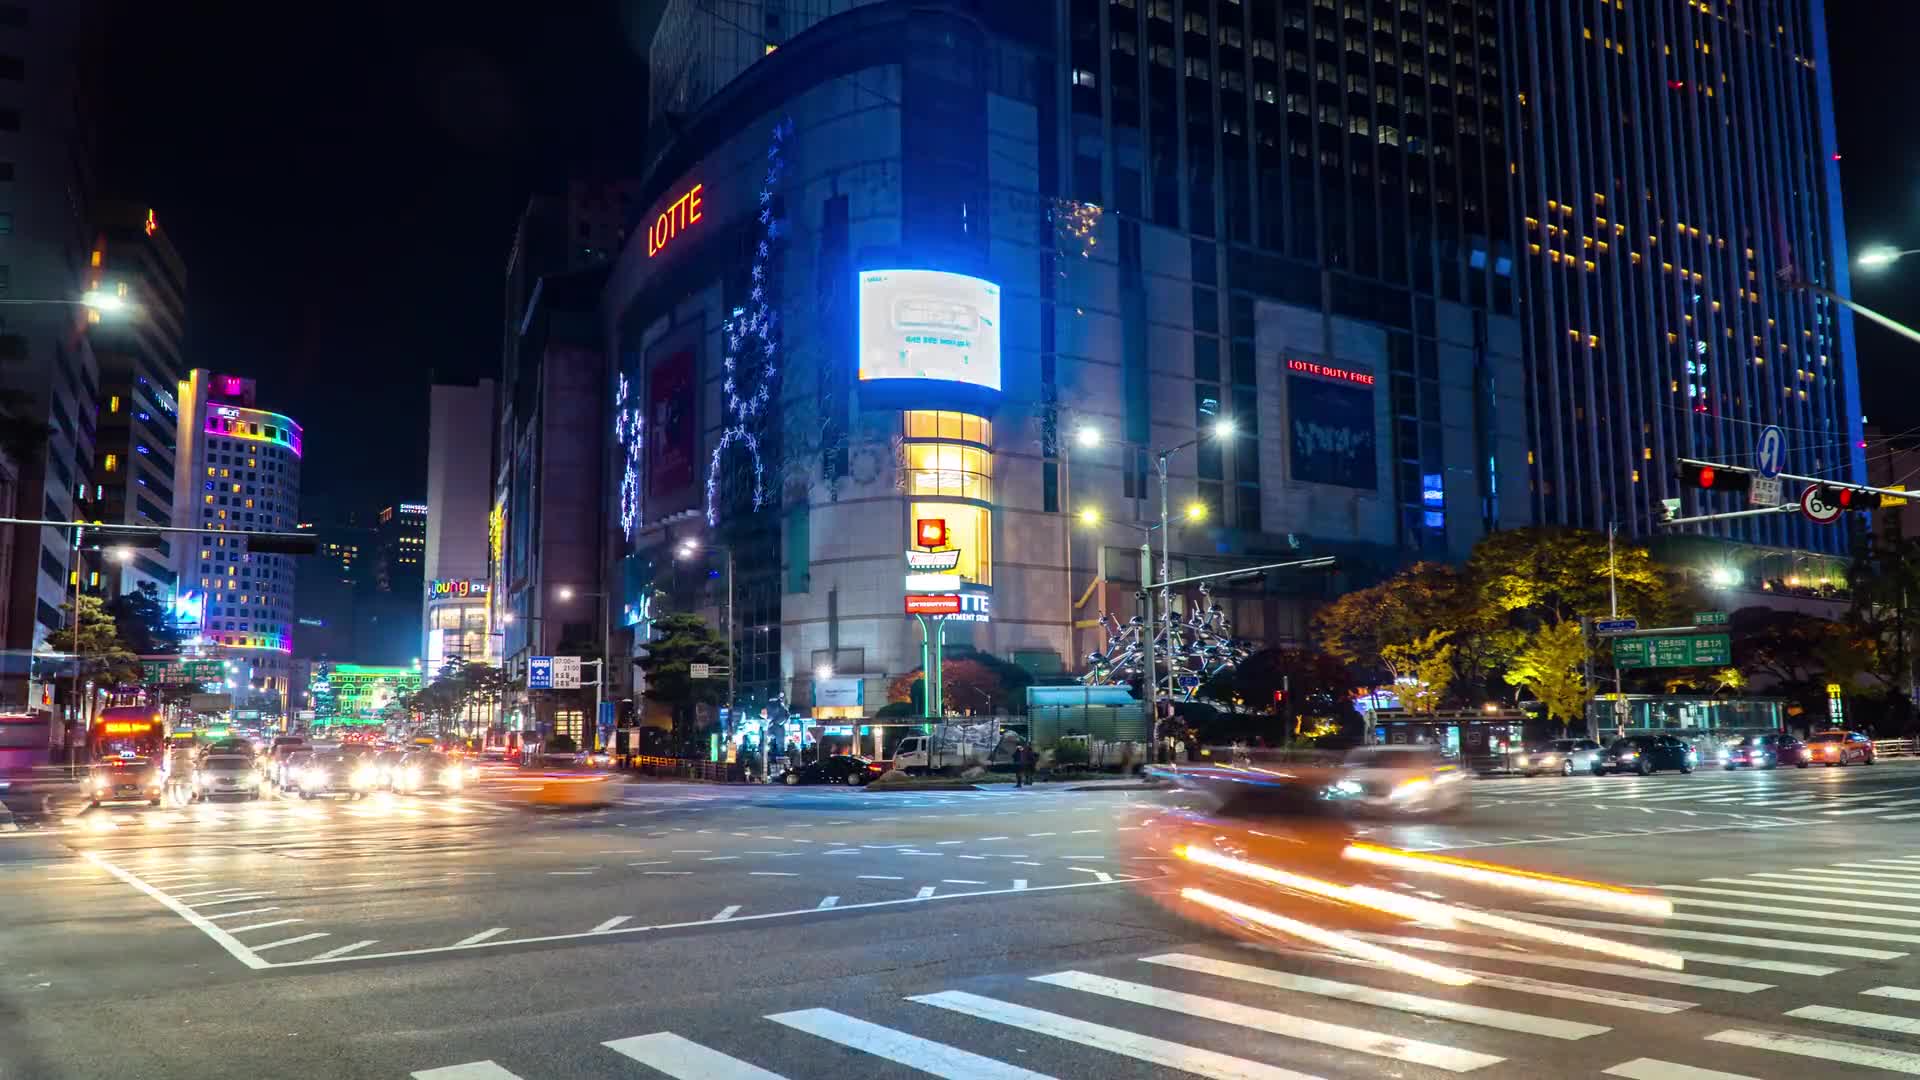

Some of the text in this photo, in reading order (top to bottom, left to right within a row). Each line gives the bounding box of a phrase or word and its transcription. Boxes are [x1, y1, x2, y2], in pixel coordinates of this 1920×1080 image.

[649, 183, 702, 257] LOTTE
[1288, 360, 1375, 385] LOTTE DUTY FREE
[430, 580, 490, 599] young PL
